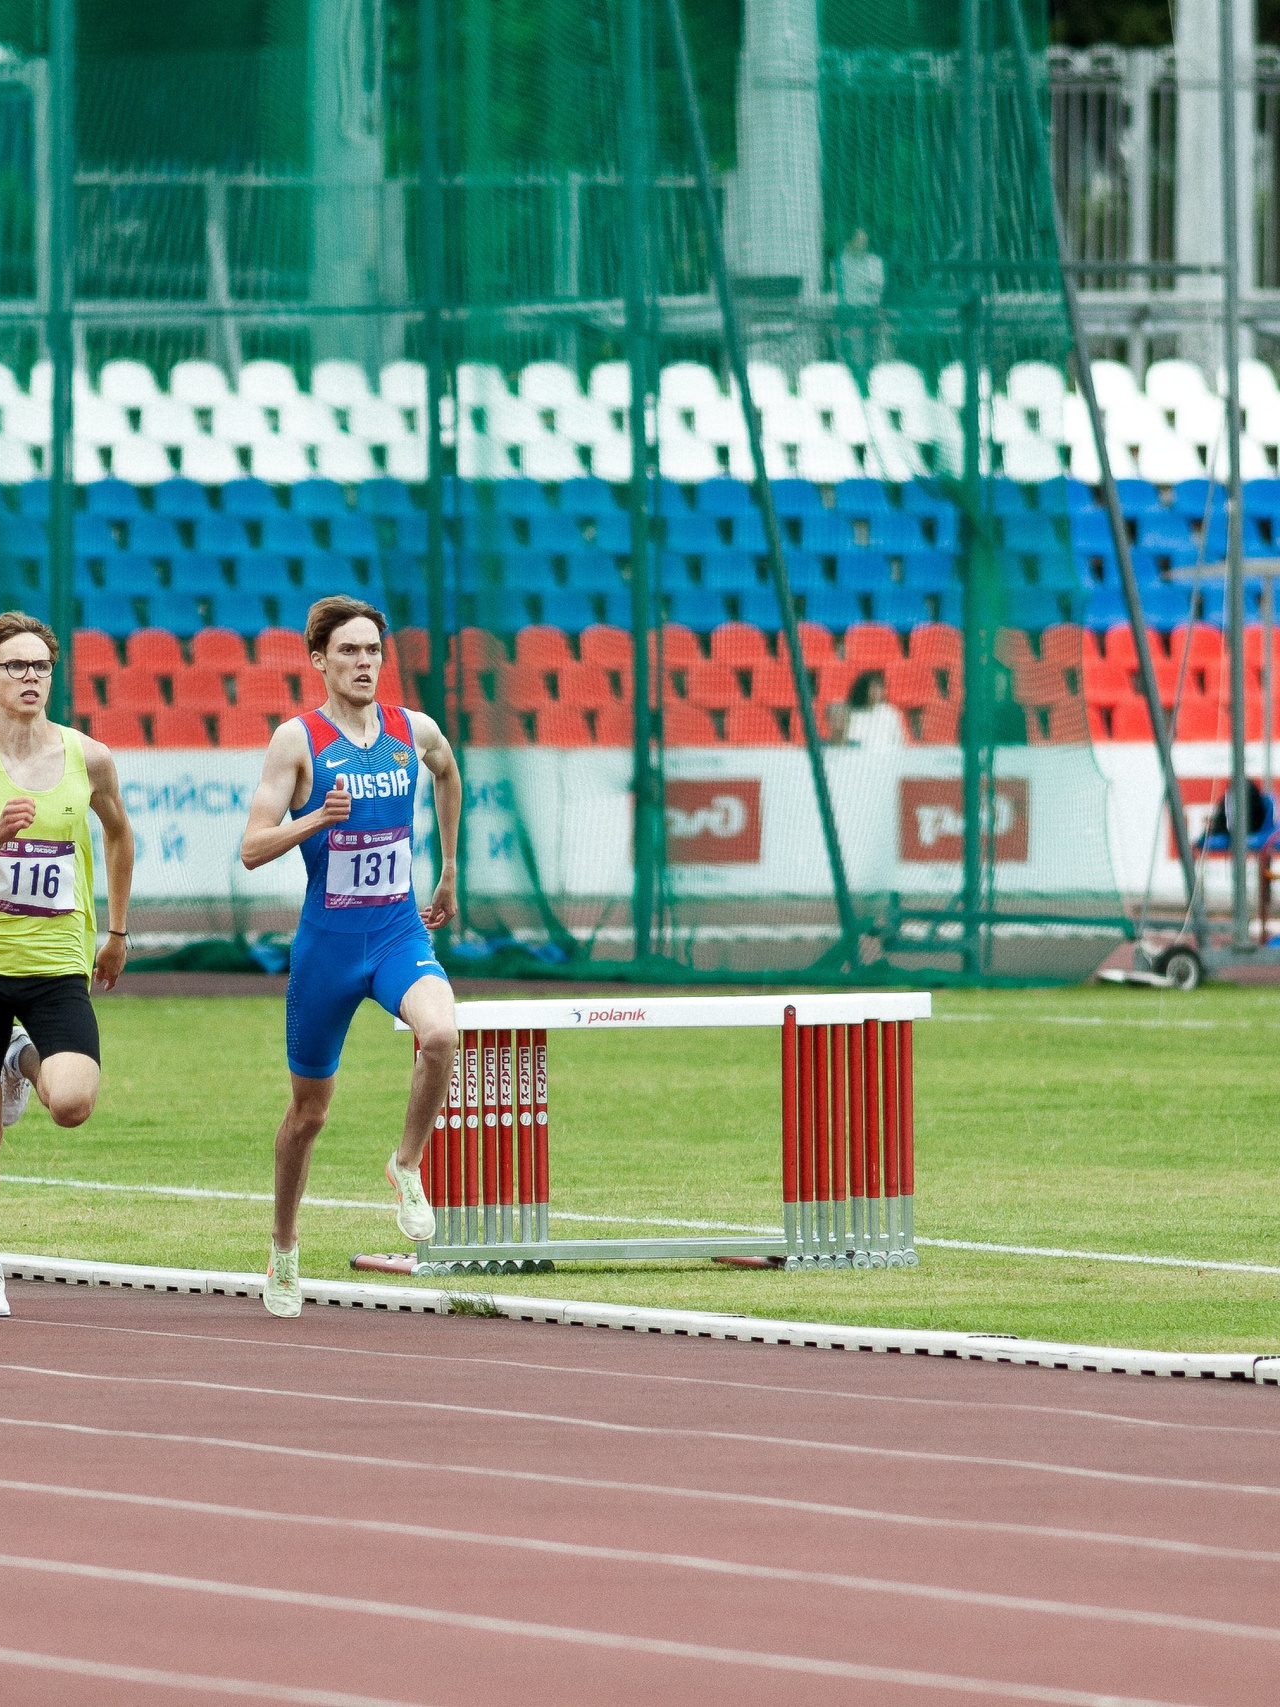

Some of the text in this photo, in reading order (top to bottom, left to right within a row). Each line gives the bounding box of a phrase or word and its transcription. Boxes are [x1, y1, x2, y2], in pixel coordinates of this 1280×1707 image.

[122, 773, 247, 816] СИЙСК
[333, 768, 411, 800] RUSSIA
[10, 862, 61, 899] 116
[351, 850, 396, 888] 131
[588, 1007, 647, 1025] polanik
[467, 1050, 477, 1102] POLANIK
[485, 1049, 495, 1101] POLANIK
[501, 1048, 511, 1100] POLANIK
[520, 1048, 530, 1100] POLANIK
[536, 1046, 546, 1099] POLANIK
